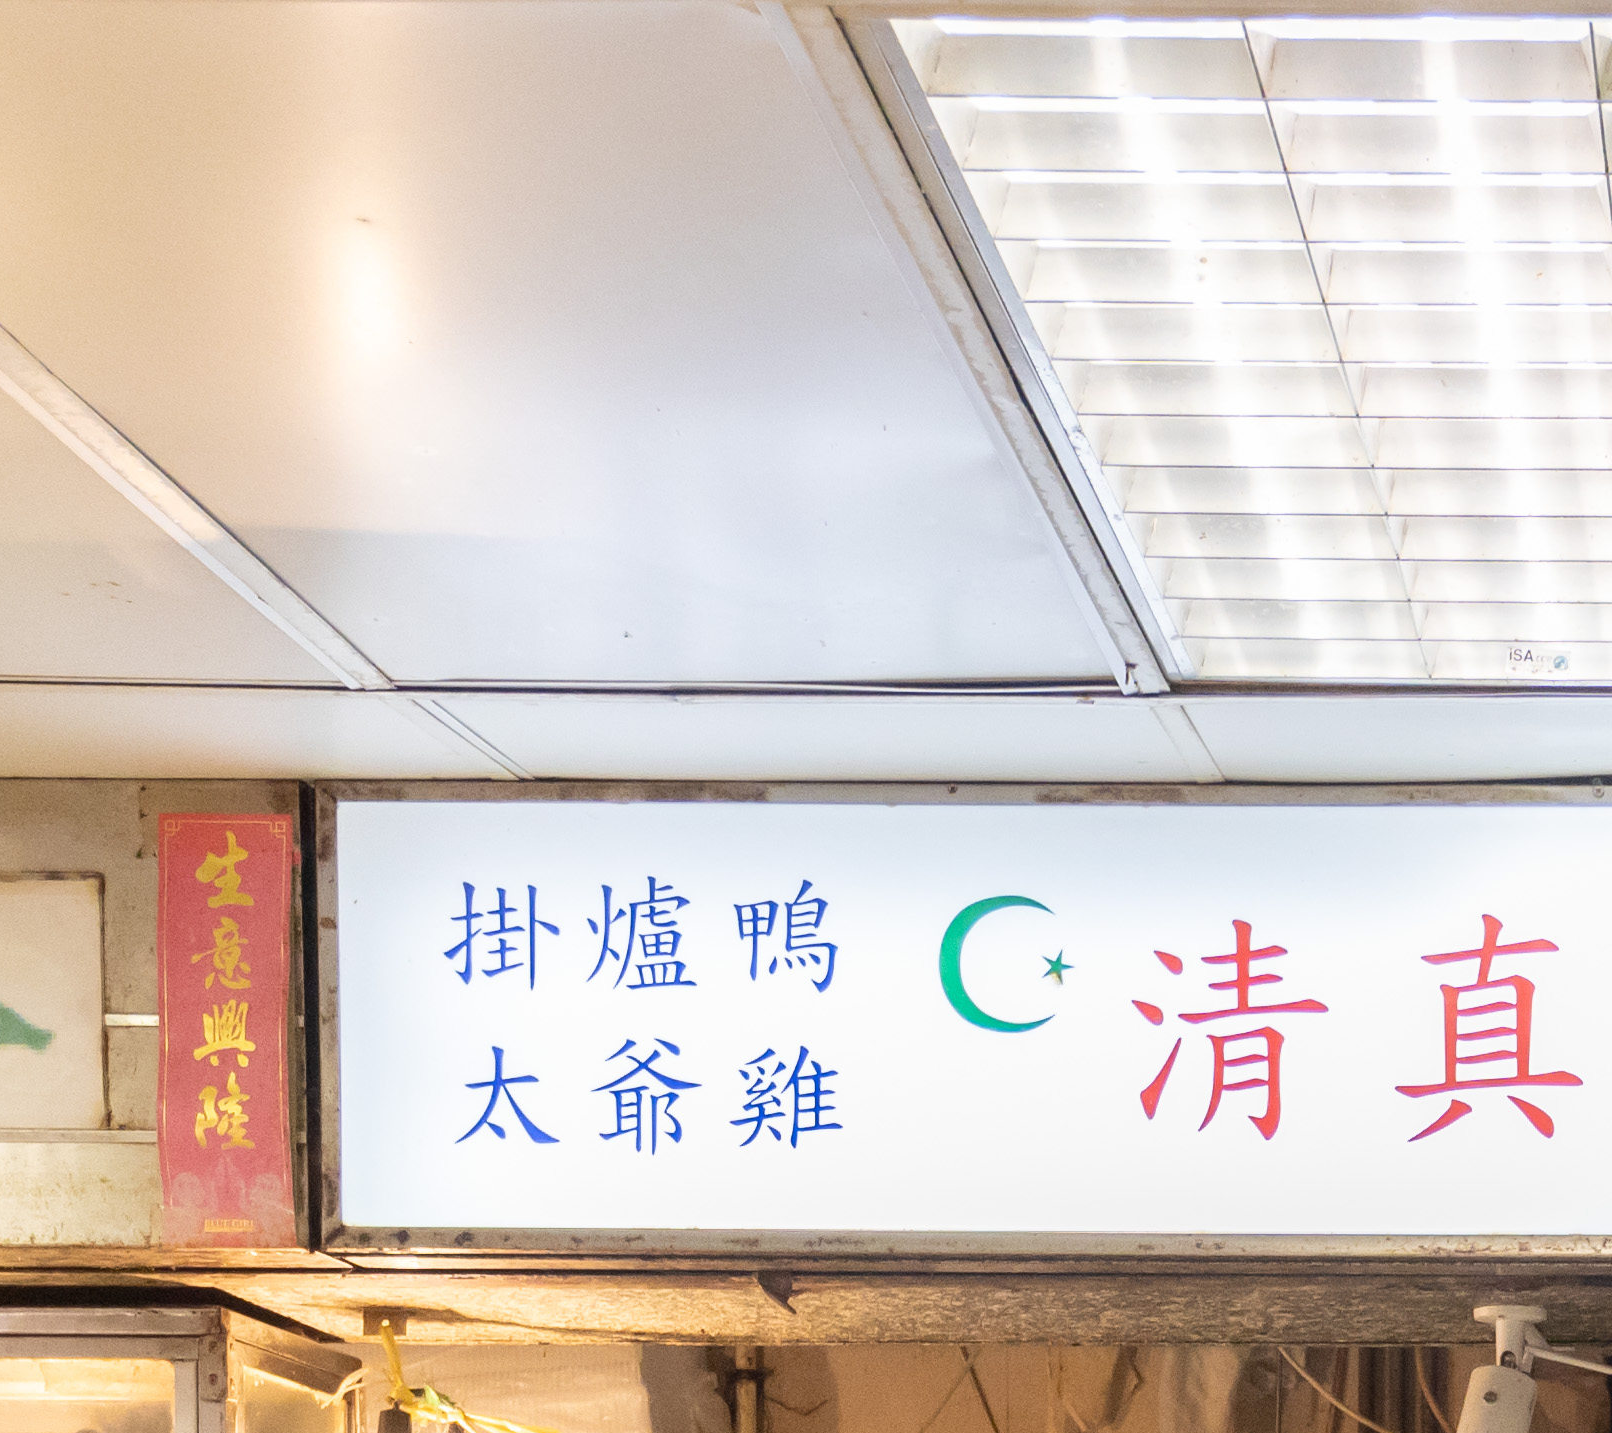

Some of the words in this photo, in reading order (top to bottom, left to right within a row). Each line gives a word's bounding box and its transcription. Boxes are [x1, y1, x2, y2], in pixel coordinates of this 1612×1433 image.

[191, 830, 256, 1150] 生意興隆
[443, 876, 839, 994] 掛爐鴨
[454, 1035, 844, 1155] 太爺雞
